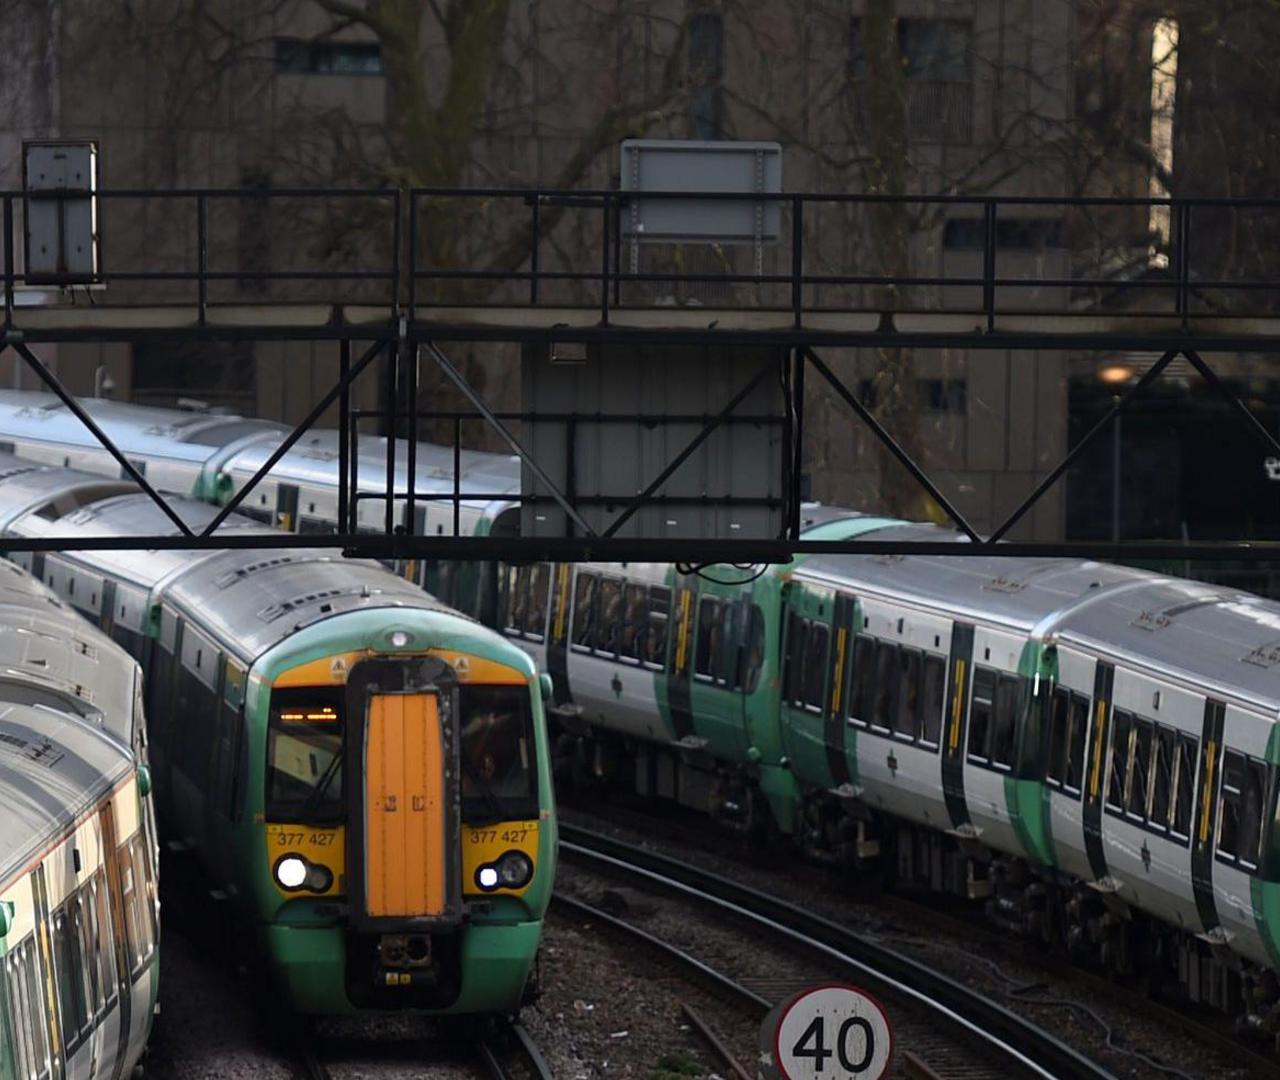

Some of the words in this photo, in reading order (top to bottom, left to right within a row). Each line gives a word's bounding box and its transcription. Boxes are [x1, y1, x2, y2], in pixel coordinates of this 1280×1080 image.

[277, 832, 304, 846] 377
[308, 832, 336, 846] 427
[470, 831, 497, 845] 377
[501, 830, 528, 844] 427
[793, 1016, 875, 1073] 40
